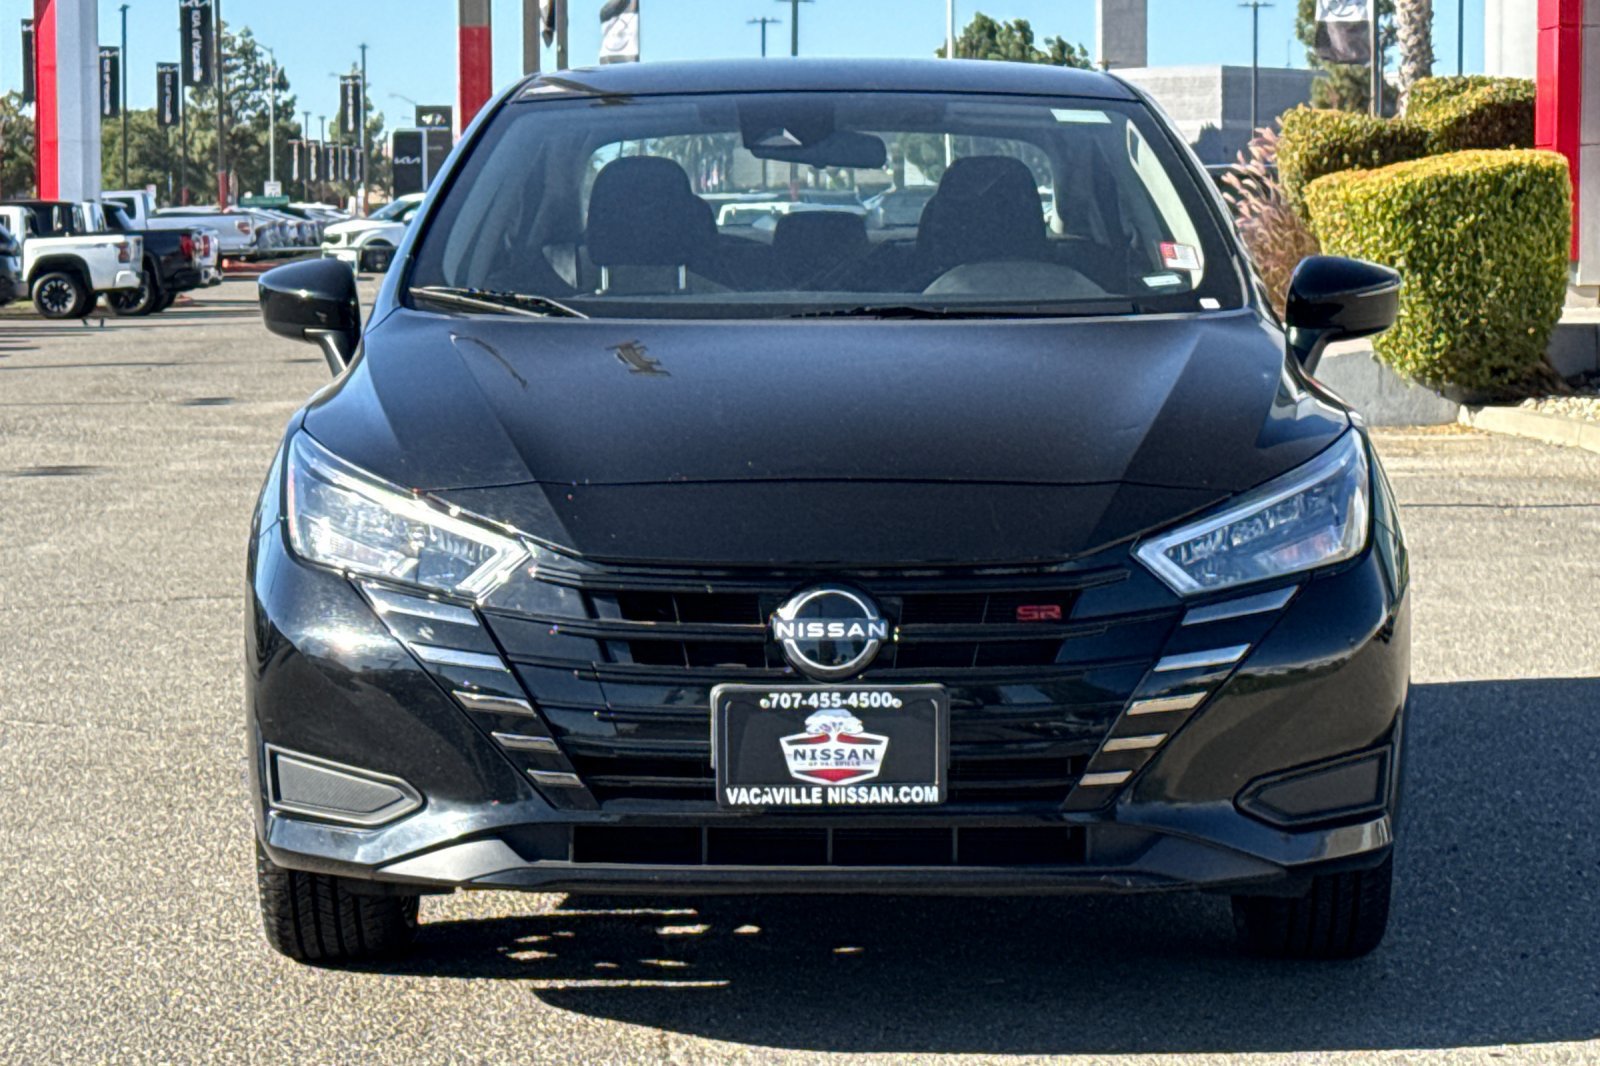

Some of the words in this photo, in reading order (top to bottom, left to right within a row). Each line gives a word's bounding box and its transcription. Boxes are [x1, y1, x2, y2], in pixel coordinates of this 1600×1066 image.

[192, 40, 203, 82] Vacav
[1016, 605, 1061, 620] SR
[776, 622, 886, 637] NISSAN
[769, 692, 893, 708] 707-455-4500
[794, 749, 875, 761] NISSAN
[726, 787, 822, 804] VACAVILLE
[828, 786, 939, 804] NISSAN.COM
